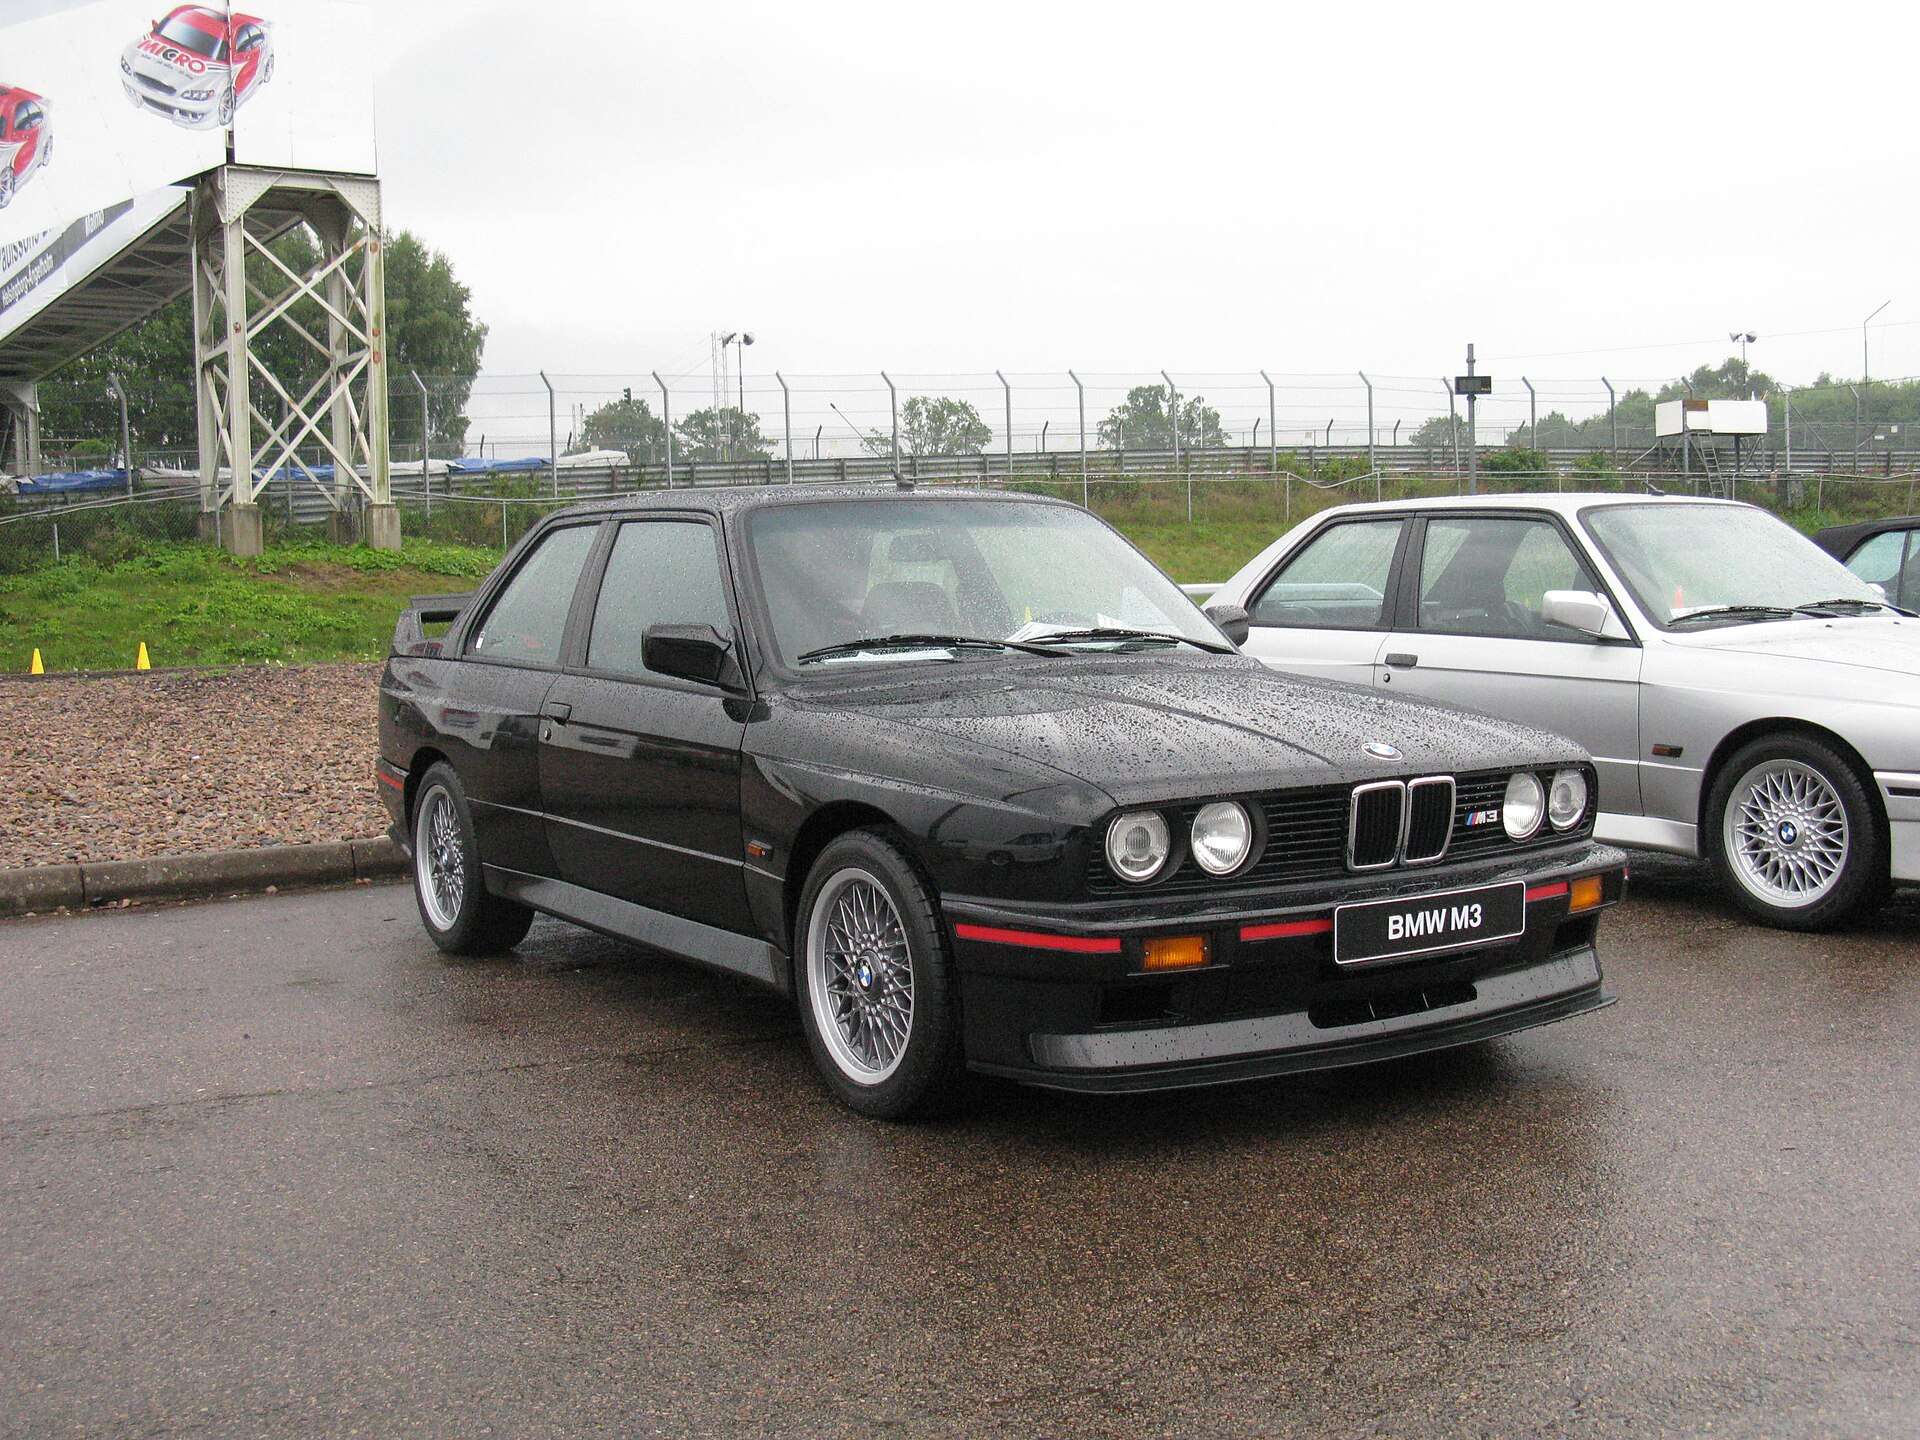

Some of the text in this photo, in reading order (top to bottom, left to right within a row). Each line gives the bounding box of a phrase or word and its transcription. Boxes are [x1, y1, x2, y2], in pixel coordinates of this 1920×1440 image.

[137, 40, 207, 75] MICRO
[1473, 810, 1498, 825] M3
[1388, 903, 1482, 940] BMW M3
